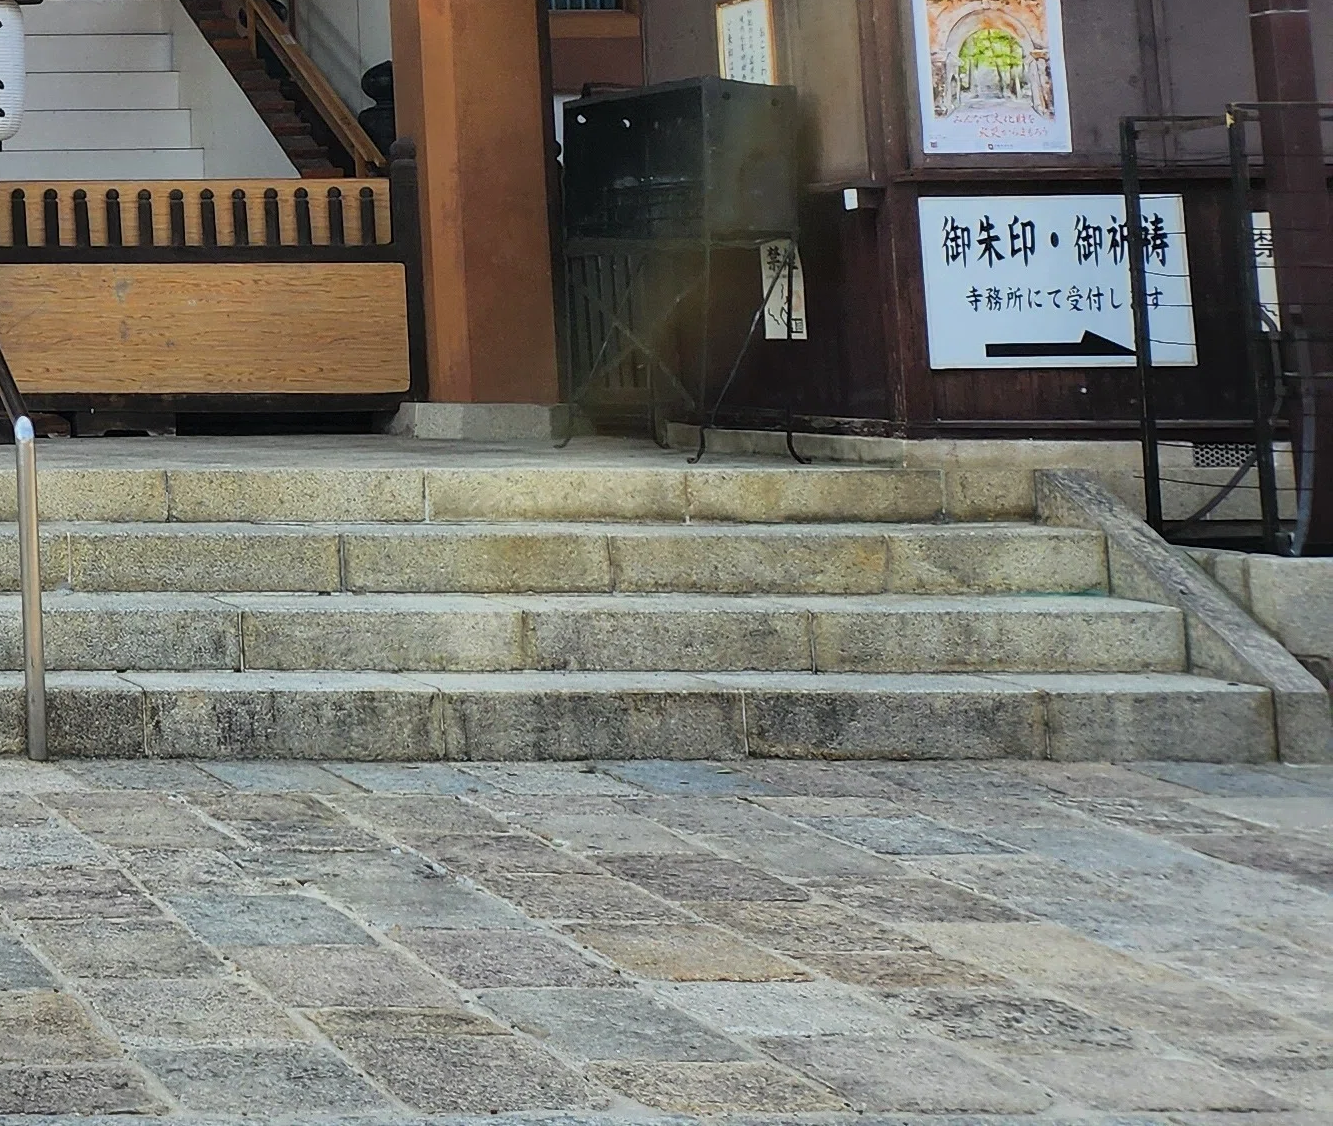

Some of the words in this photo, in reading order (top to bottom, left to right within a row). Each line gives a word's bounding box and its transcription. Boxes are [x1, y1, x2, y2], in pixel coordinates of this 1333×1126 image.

[965, 285, 1164, 312] 寺務所にて受付しす
